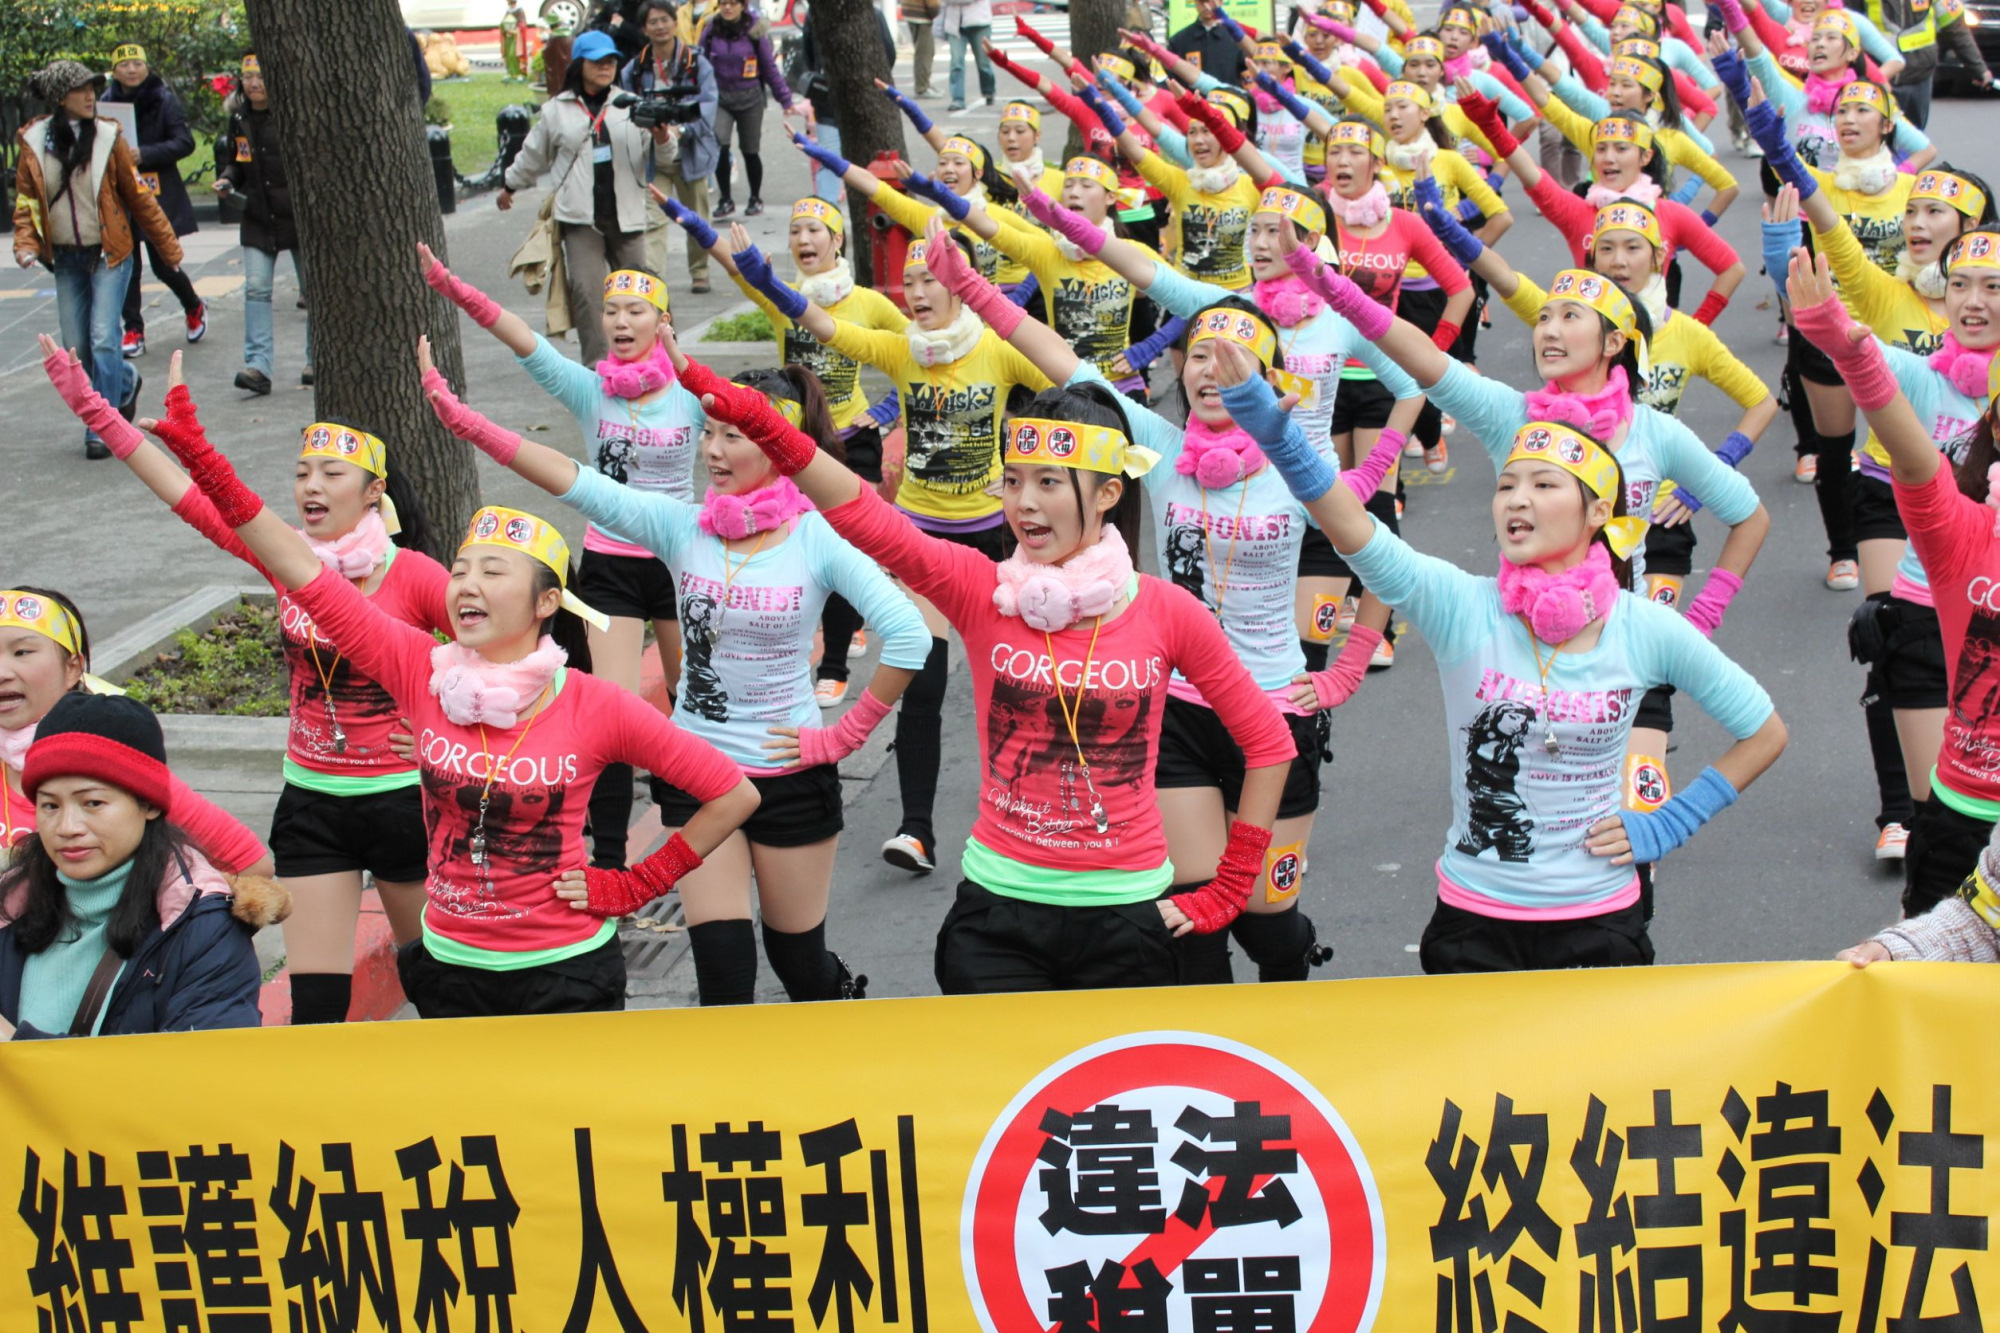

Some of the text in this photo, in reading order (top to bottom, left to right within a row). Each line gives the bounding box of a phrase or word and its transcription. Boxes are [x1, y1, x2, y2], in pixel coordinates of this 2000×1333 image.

[1164, 502, 1291, 542] HEDONIST
[679, 571, 803, 612] HEDONIST
[749, 621, 771, 629] SALT
[990, 642, 1162, 690] GORGEOUS
[1475, 667, 1633, 724] HEDONIST
[420, 728, 578, 786] GORGEOUS
[1576, 736, 1602, 744] SALT
[1530, 772, 1558, 781] LOVE
[1561, 773, 1572, 782] IS
[1021, 810, 1084, 837] Better
[1036, 836, 1080, 849] between
[1083, 839, 1102, 851] you
[1105, 838, 1112, 848] &
[1037, 1099, 1304, 1237] 違法
[14, 1114, 928, 1333] 維護納稅人權利
[1424, 1081, 1989, 1333] 終結違法
